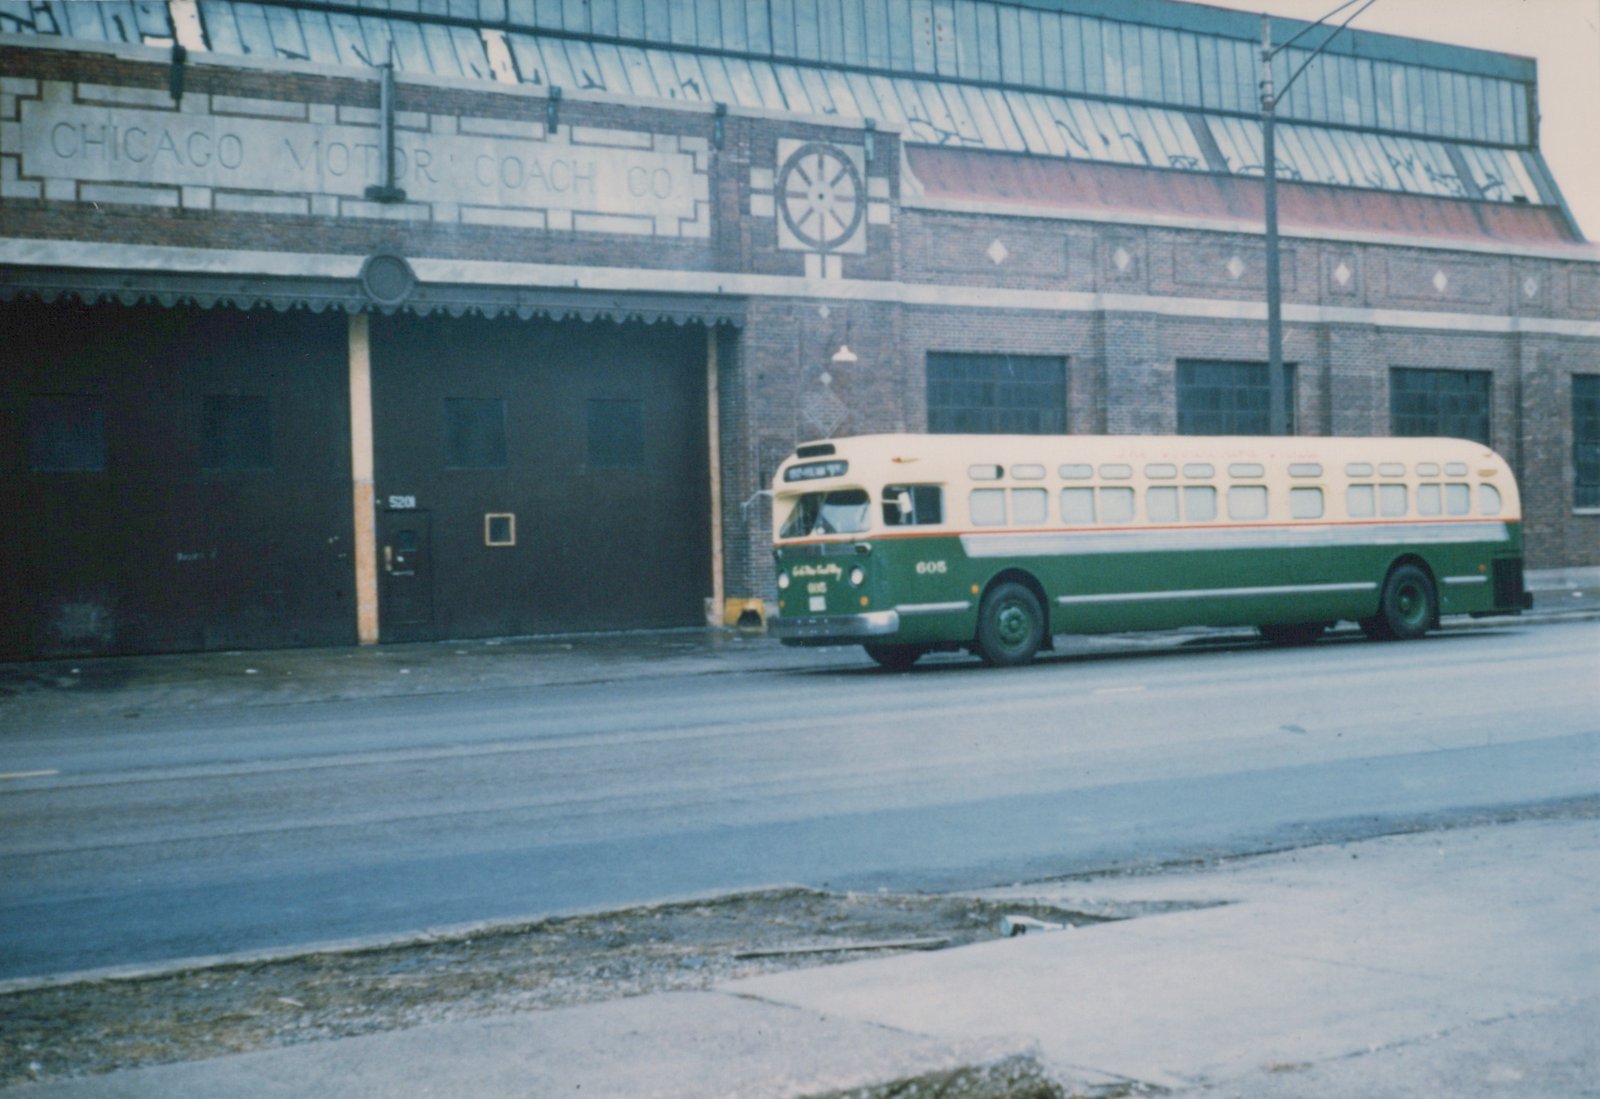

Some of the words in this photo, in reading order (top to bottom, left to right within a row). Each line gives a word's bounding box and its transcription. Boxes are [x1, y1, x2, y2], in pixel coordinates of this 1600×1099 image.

[50, 121, 243, 170] CHICAGO
[284, 137, 439, 184] MOTOR
[474, 154, 596, 194] COACH
[916, 560, 947, 574] 605
